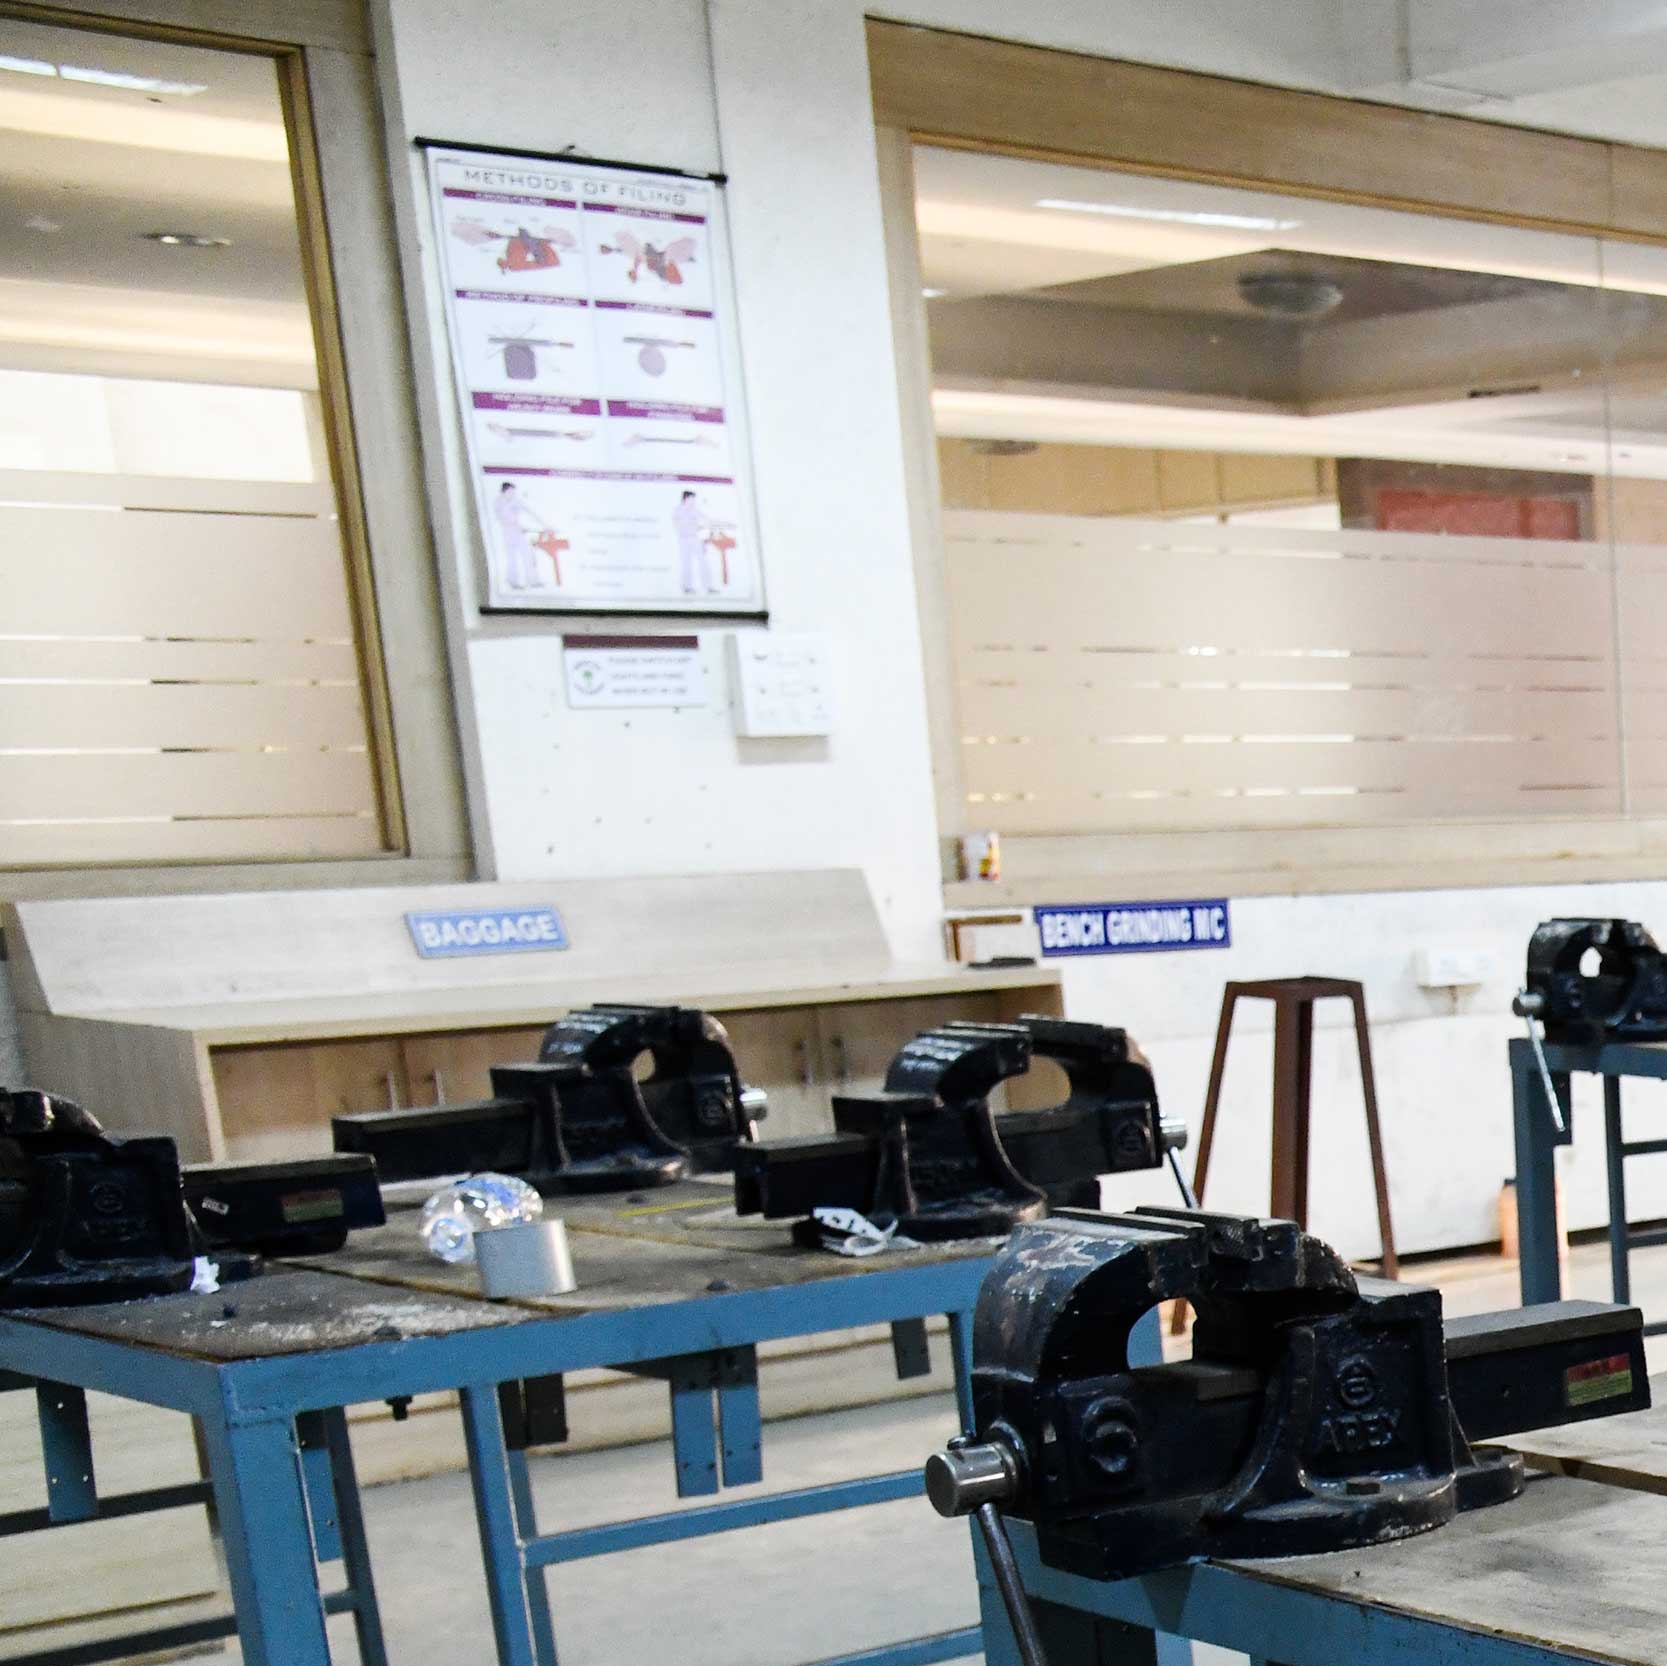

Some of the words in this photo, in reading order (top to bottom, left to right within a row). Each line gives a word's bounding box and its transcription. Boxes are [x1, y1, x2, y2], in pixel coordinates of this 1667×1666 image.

[464, 169, 574, 193] METHODS
[584, 177, 609, 196] OF
[618, 185, 687, 207] FILING
[420, 913, 559, 948] BAGGAGE
[1041, 911, 1105, 948] BENCH
[1106, 908, 1192, 945] GRINDING
